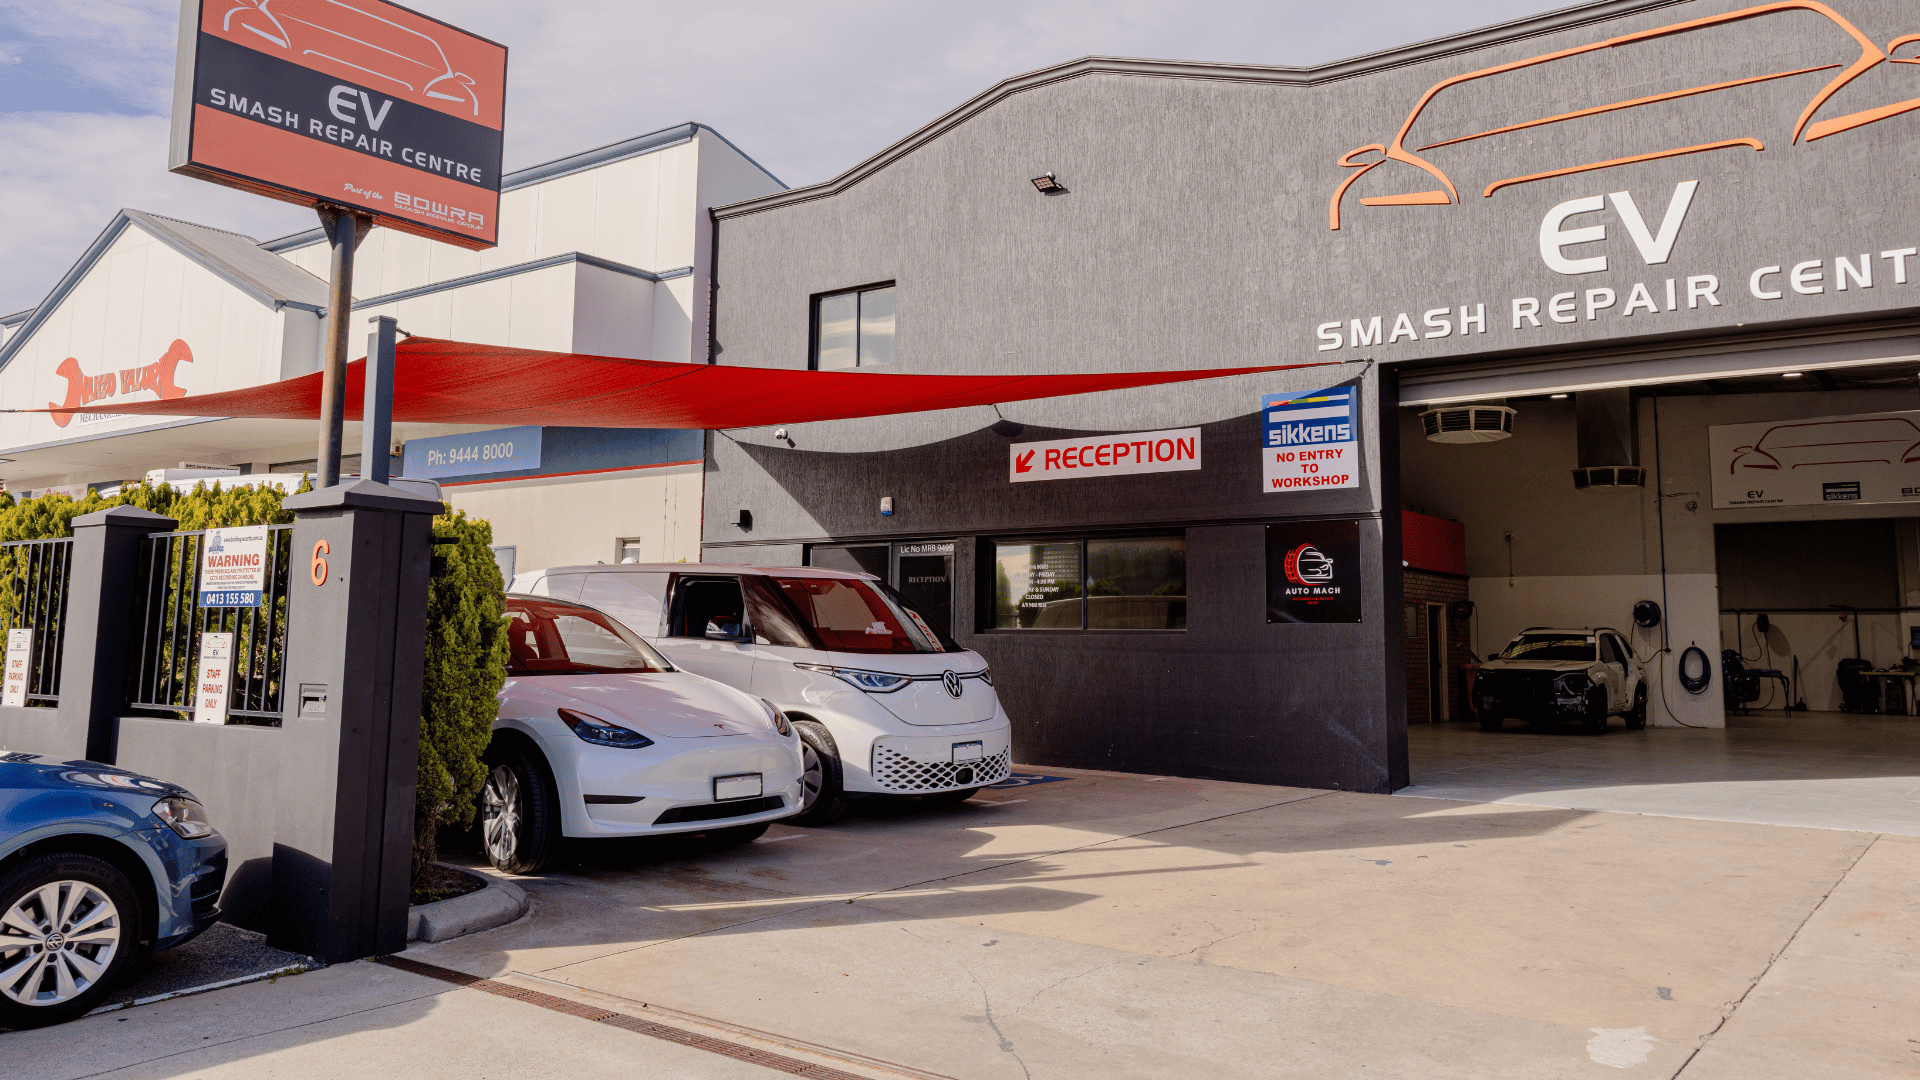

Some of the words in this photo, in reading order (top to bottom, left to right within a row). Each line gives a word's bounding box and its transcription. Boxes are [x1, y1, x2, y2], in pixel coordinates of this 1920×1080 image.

[328, 84, 393, 131] EV
[210, 88, 299, 129] SMASH
[309, 118, 393, 157] REPAIR
[401, 147, 482, 183] CENTRE
[343, 182, 363, 194] Part
[363, 190, 371, 200] of
[372, 191, 384, 200] the
[394, 191, 484, 225] BOWRA
[394, 203, 425, 215] SMASH
[426, 212, 455, 223] REPAIR
[456, 220, 484, 230] GROUP
[1539, 179, 1700, 276] EV
[1317, 303, 1487, 351] SMASH
[1513, 274, 1721, 330] REPAIR
[1269, 423, 1350, 446] sikkens
[427, 449, 446, 466] Ph:
[449, 446, 479, 465] 9444
[482, 441, 513, 461] 8000
[1044, 436, 1196, 471] RECEPTION
[1276, 452, 1296, 464] NO
[1299, 448, 1344, 462] ENTRY
[1300, 463, 1319, 474] TO
[1271, 474, 1350, 489] WORKSHOP
[1747, 490, 1764, 499] EV
[900, 545, 910, 554] Lic
[911, 545, 921, 553] No
[921, 544, 936, 553] MRB
[208, 553, 260, 568] WARNING
[311, 539, 331, 587] 6
[908, 576, 946, 584] RECEPTION
[206, 593, 225, 604] 0413
[226, 593, 239, 604] 155
[240, 592, 254, 604] 580
[1285, 587, 1310, 595] AUTO
[1313, 586, 1341, 595] MACH
[11, 660, 22, 668] STAFF
[8, 672, 23, 681] PARKING
[206, 669, 221, 679] STAFF
[202, 683, 223, 694] PARKING
[205, 698, 217, 708] ONLY
